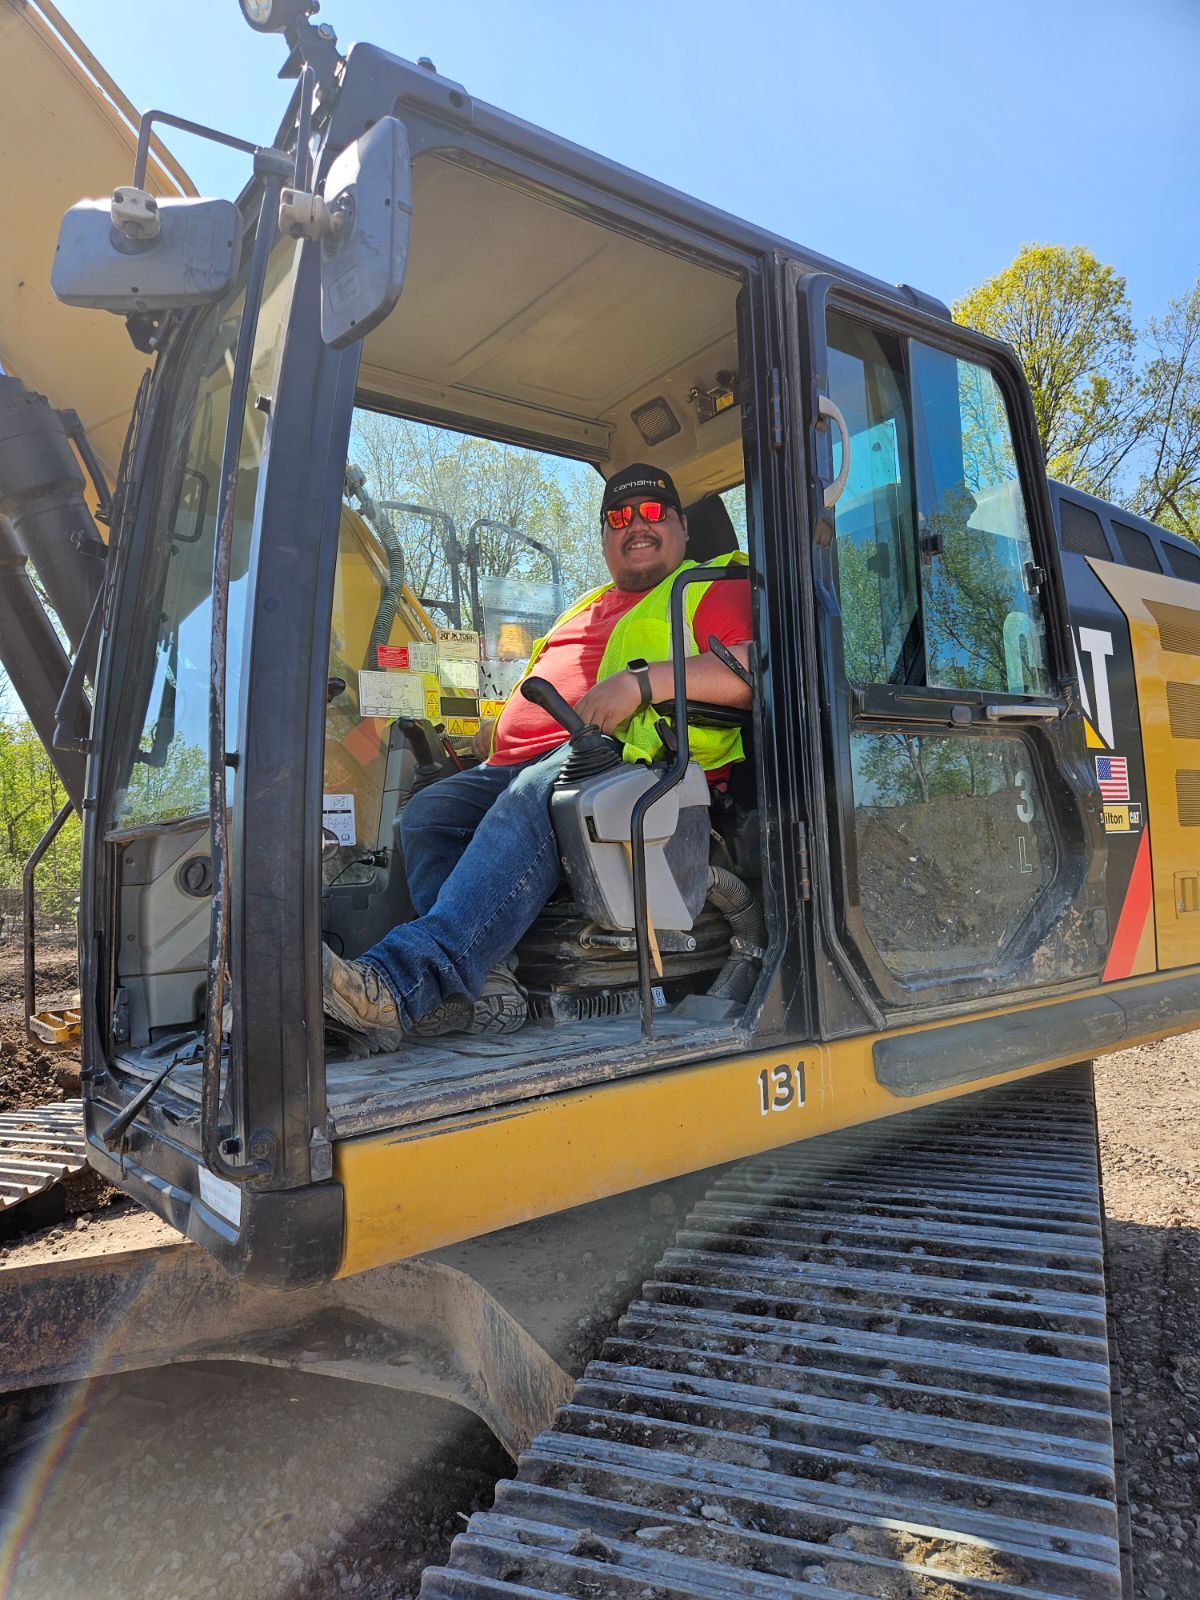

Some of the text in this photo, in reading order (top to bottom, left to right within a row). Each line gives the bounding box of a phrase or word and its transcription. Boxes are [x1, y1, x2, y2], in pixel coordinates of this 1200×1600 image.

[613, 480, 657, 493] carhartt
[1104, 812, 1124, 825] ilton
[757, 1060, 806, 1117] 131
